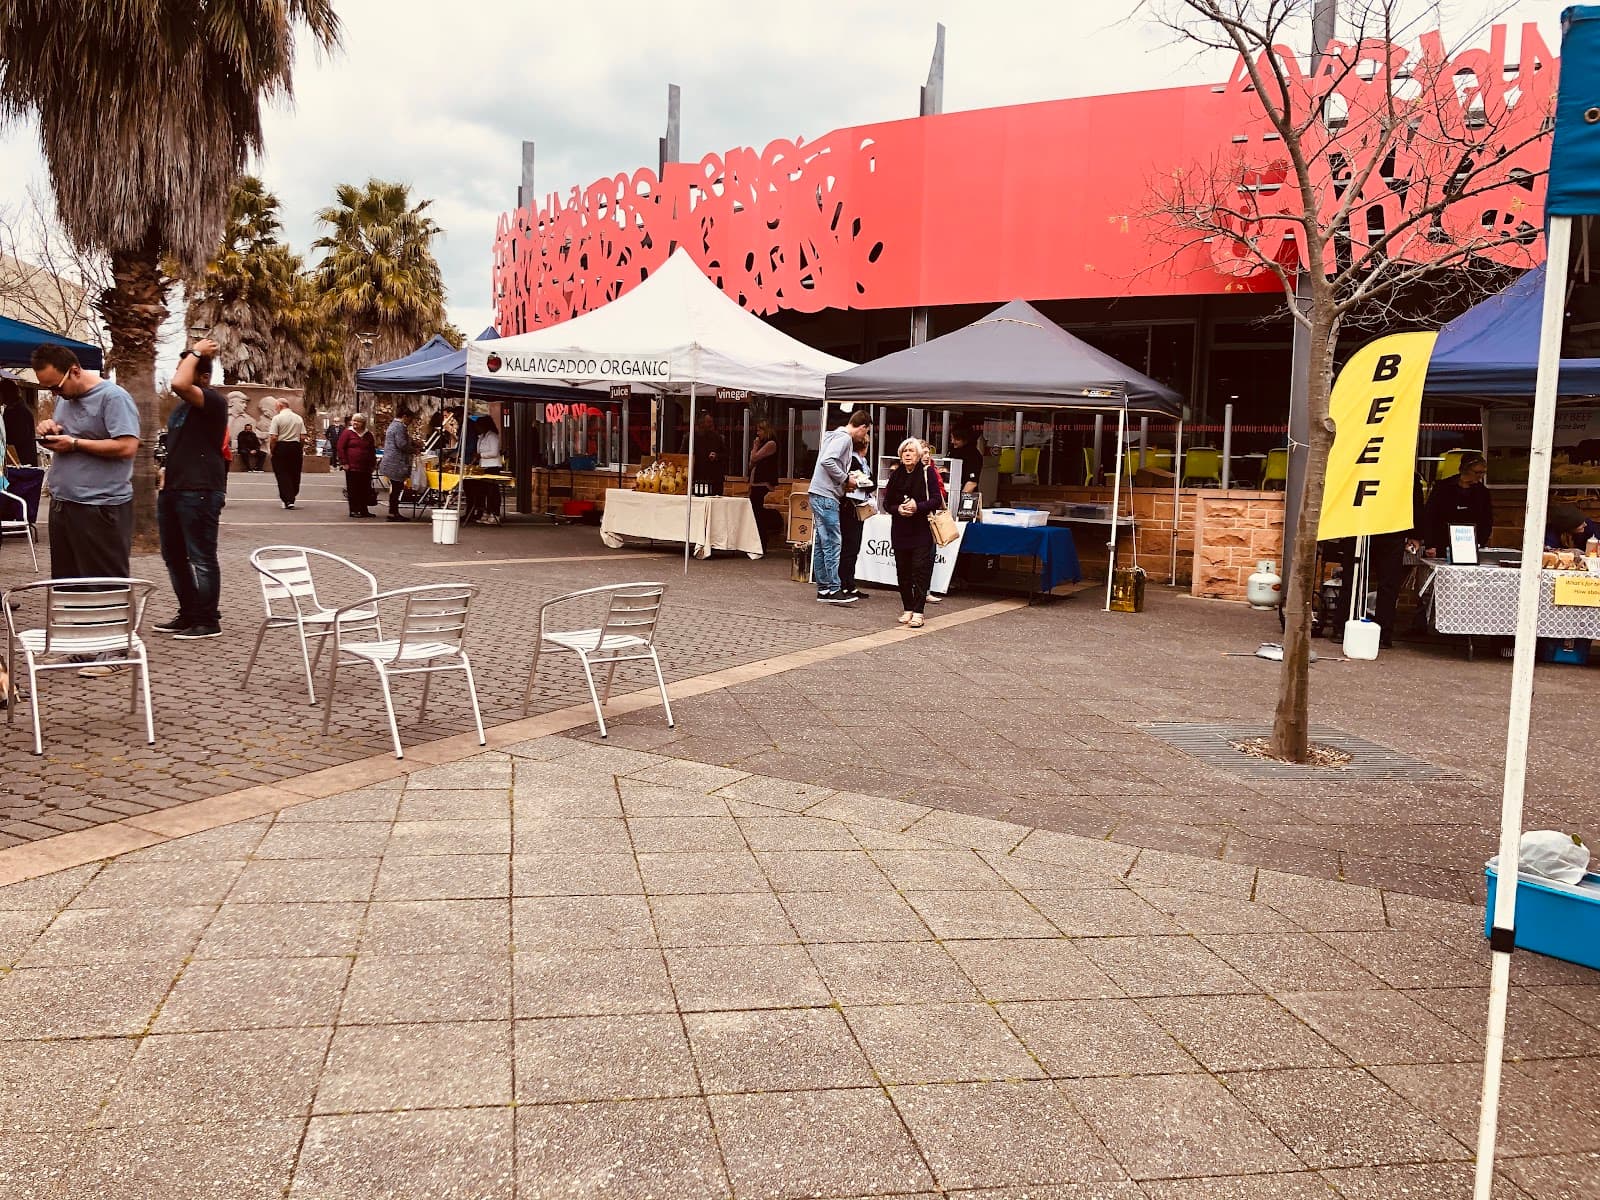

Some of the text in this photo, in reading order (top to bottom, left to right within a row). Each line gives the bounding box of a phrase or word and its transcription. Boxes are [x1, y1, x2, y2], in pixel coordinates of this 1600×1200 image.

[505, 357, 669, 376] KALANGADOO ORGANIC
[610, 386, 629, 398] juice
[718, 389, 749, 400] vinegar
[1352, 354, 1402, 507] BEEF
